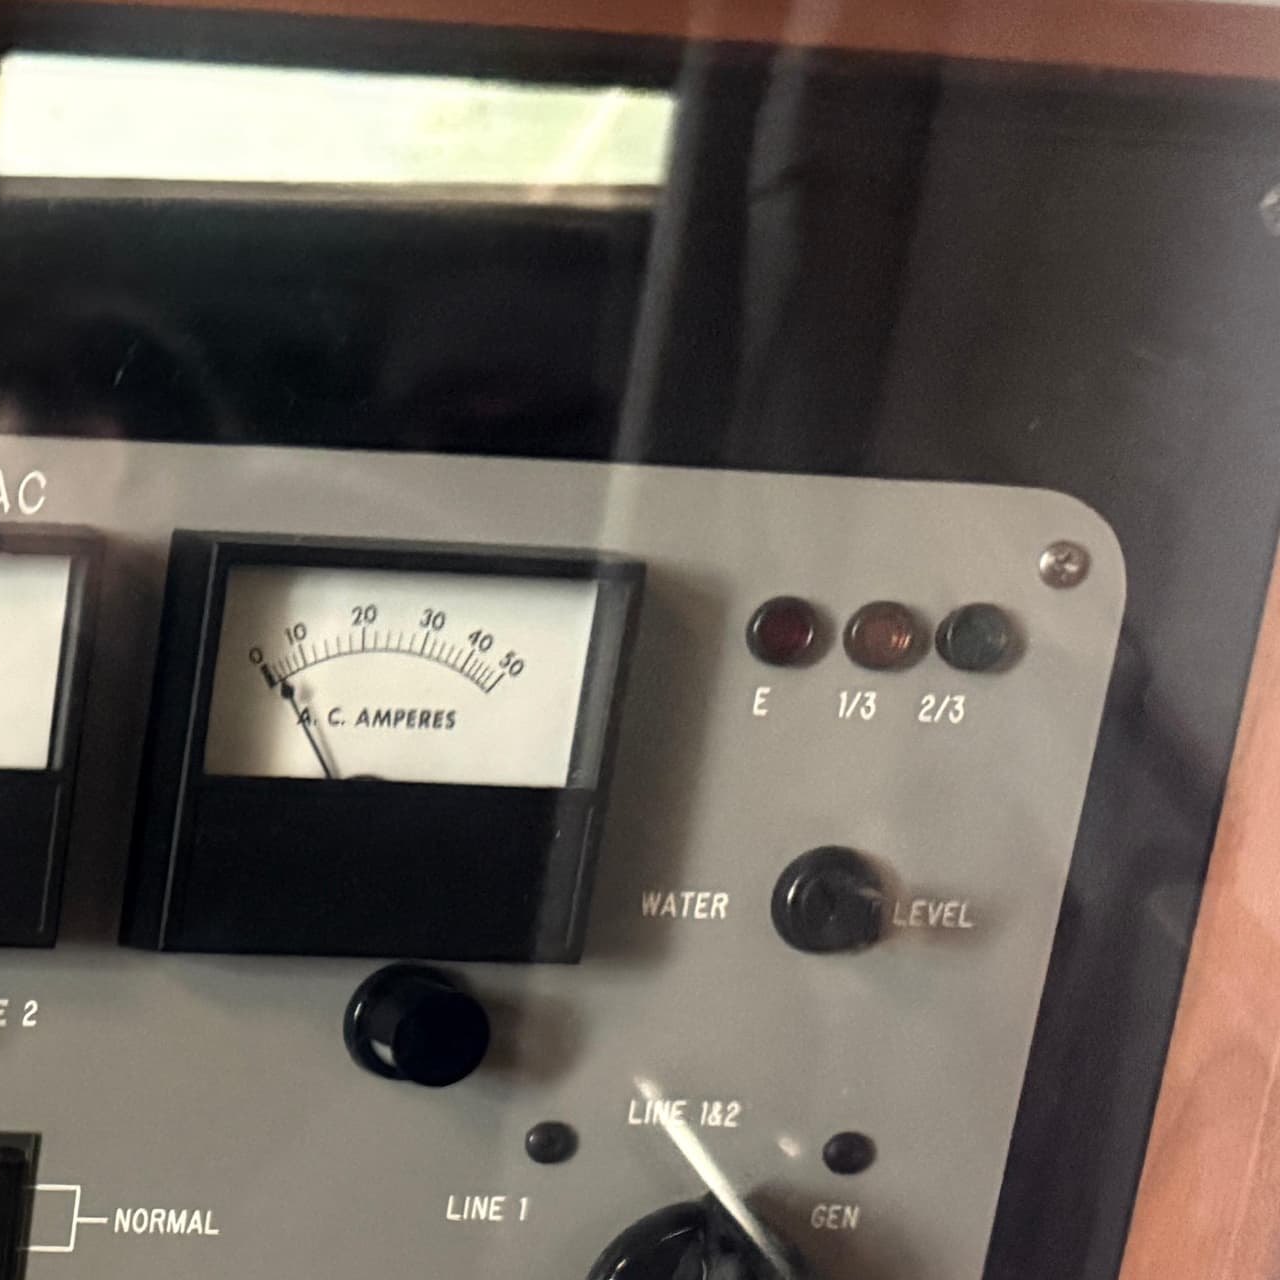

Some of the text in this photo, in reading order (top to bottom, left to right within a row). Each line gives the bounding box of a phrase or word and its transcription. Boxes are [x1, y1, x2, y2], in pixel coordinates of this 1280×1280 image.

[351, 604, 378, 625] 20
[419, 608, 446, 631] 30
[285, 623, 308, 647] 10
[467, 629, 494, 654] 40
[249, 648, 263, 665] 0
[499, 651, 526, 678] 50
[752, 687, 770, 716] E
[839, 691, 877, 721] 1/3
[918, 695, 966, 724] 2/3
[296, 707, 456, 730] A. C. AMPERES
[642, 891, 974, 929] WATER LEVEL
[22, 1001, 39, 1026] 2
[628, 1100, 741, 1128] LINE 1&2
[446, 1195, 529, 1221] LINE 1
[811, 1204, 859, 1230] GEN
[114, 1208, 220, 1236] NORMAL
